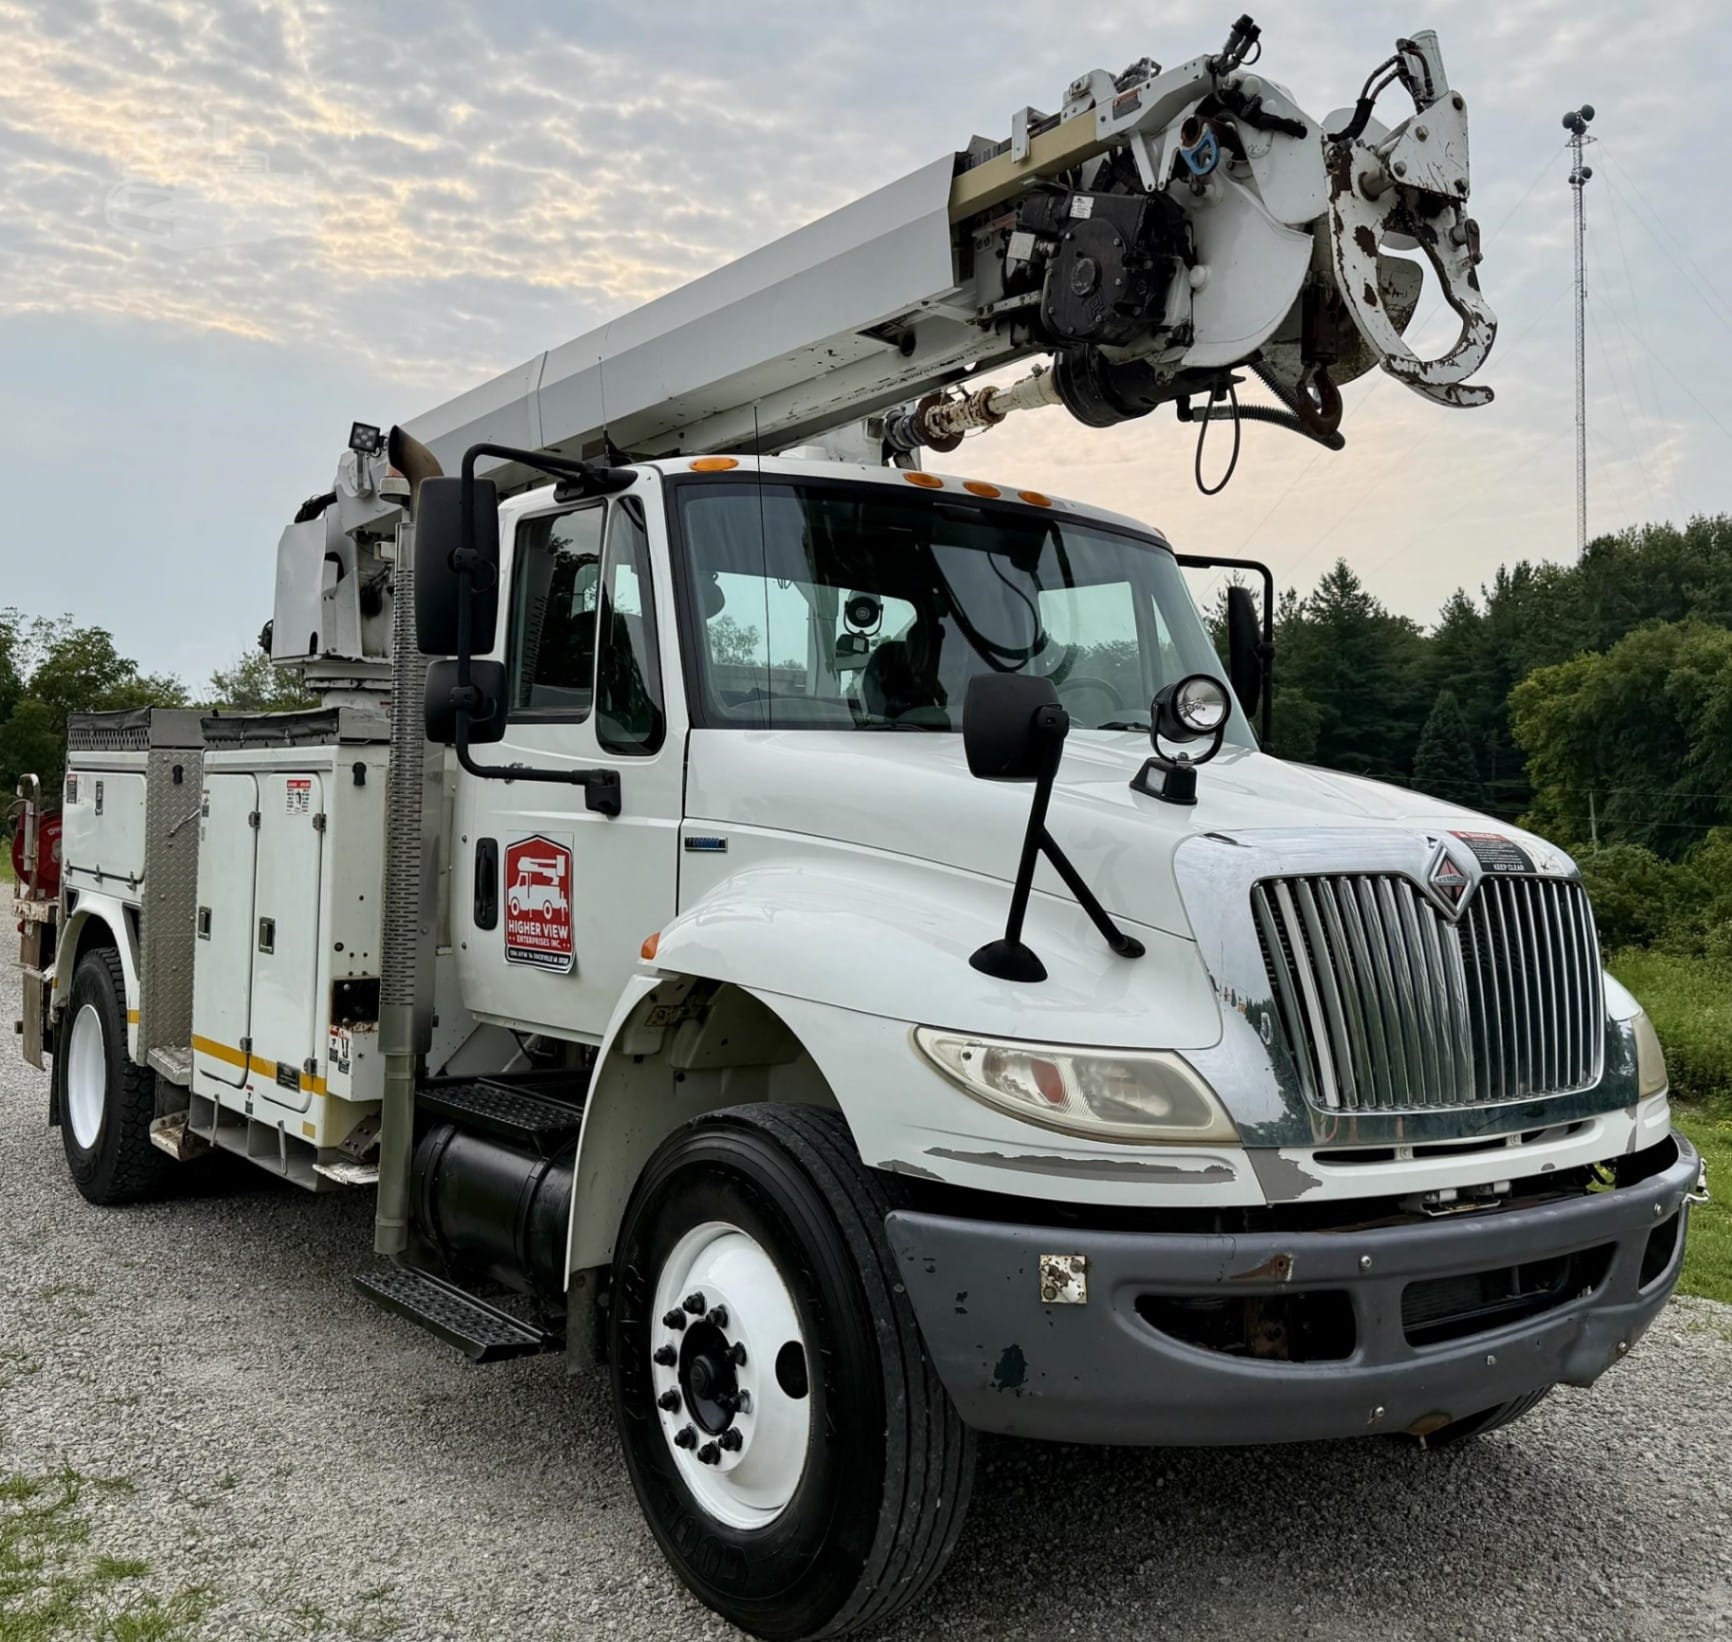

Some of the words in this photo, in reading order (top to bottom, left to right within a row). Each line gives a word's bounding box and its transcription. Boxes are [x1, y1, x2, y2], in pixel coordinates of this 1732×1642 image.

[508, 919, 541, 936] HIGHER
[542, 923, 568, 939] VIEW
[516, 935, 549, 946] ENTERPRISES
